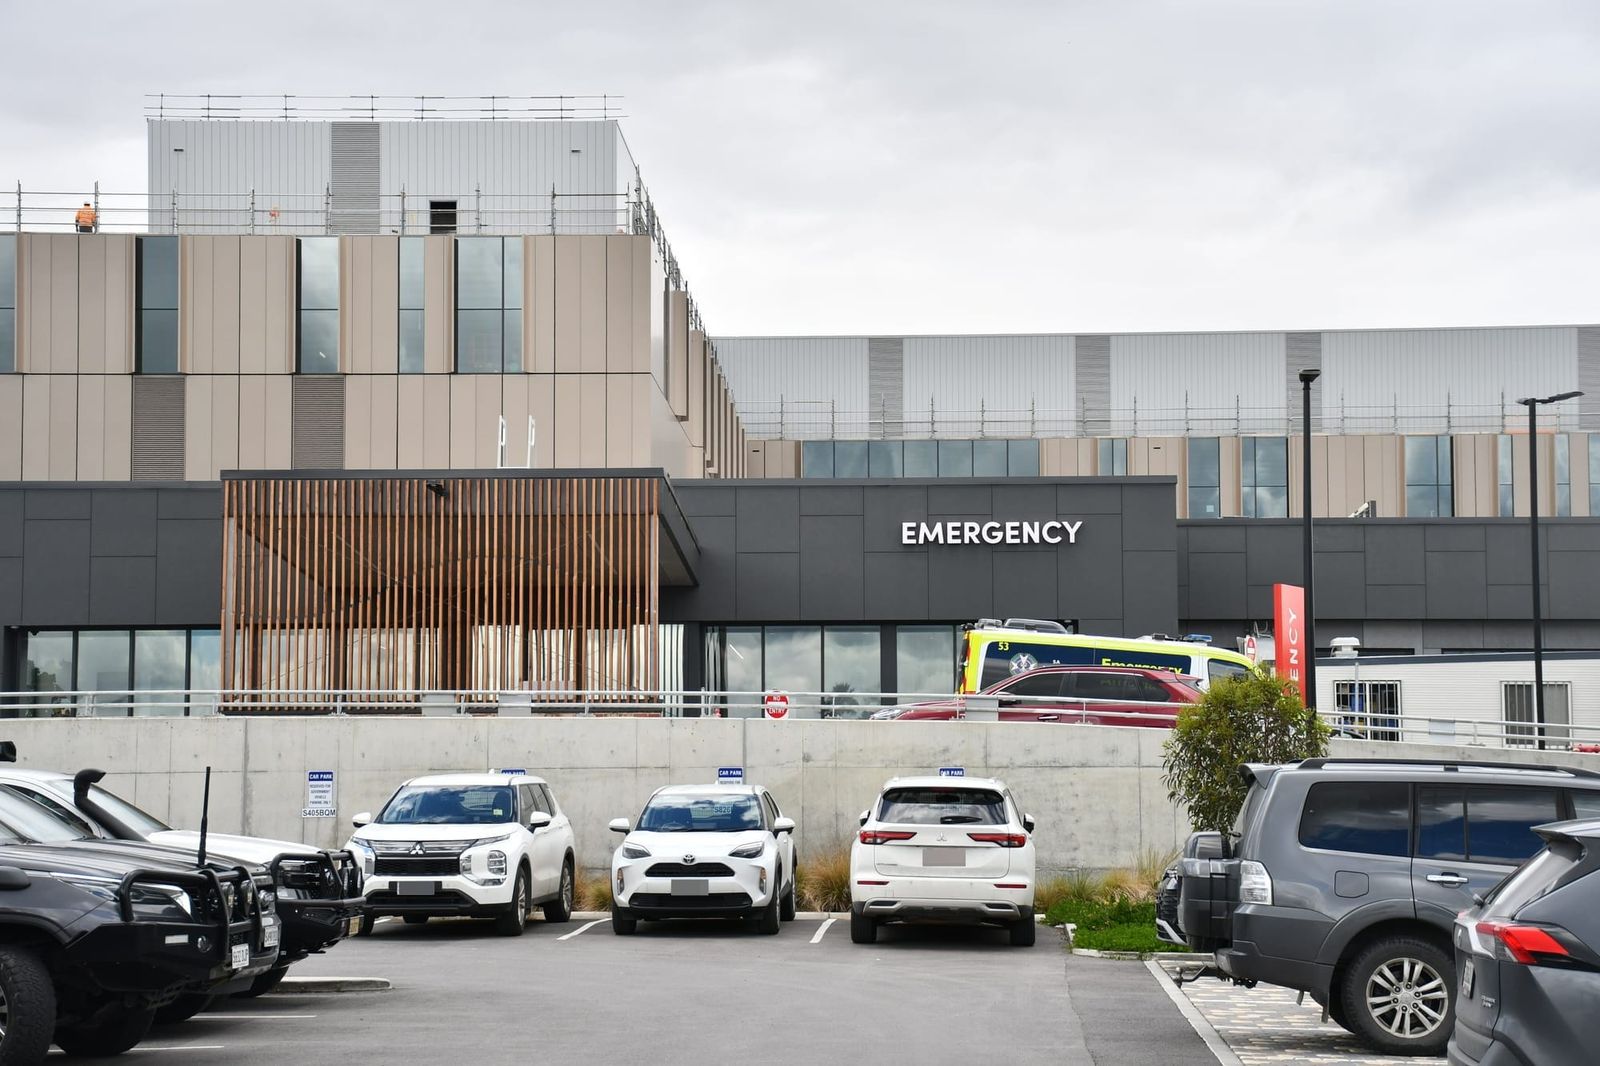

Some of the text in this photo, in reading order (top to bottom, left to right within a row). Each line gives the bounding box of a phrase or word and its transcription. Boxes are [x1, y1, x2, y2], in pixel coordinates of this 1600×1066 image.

[902, 520, 1083, 545] EMERGENCY
[997, 641, 1009, 651] 53
[1288, 607, 1299, 682] ENCY
[302, 809, 336, 817] S405BQM
[714, 806, 732, 814] S826
